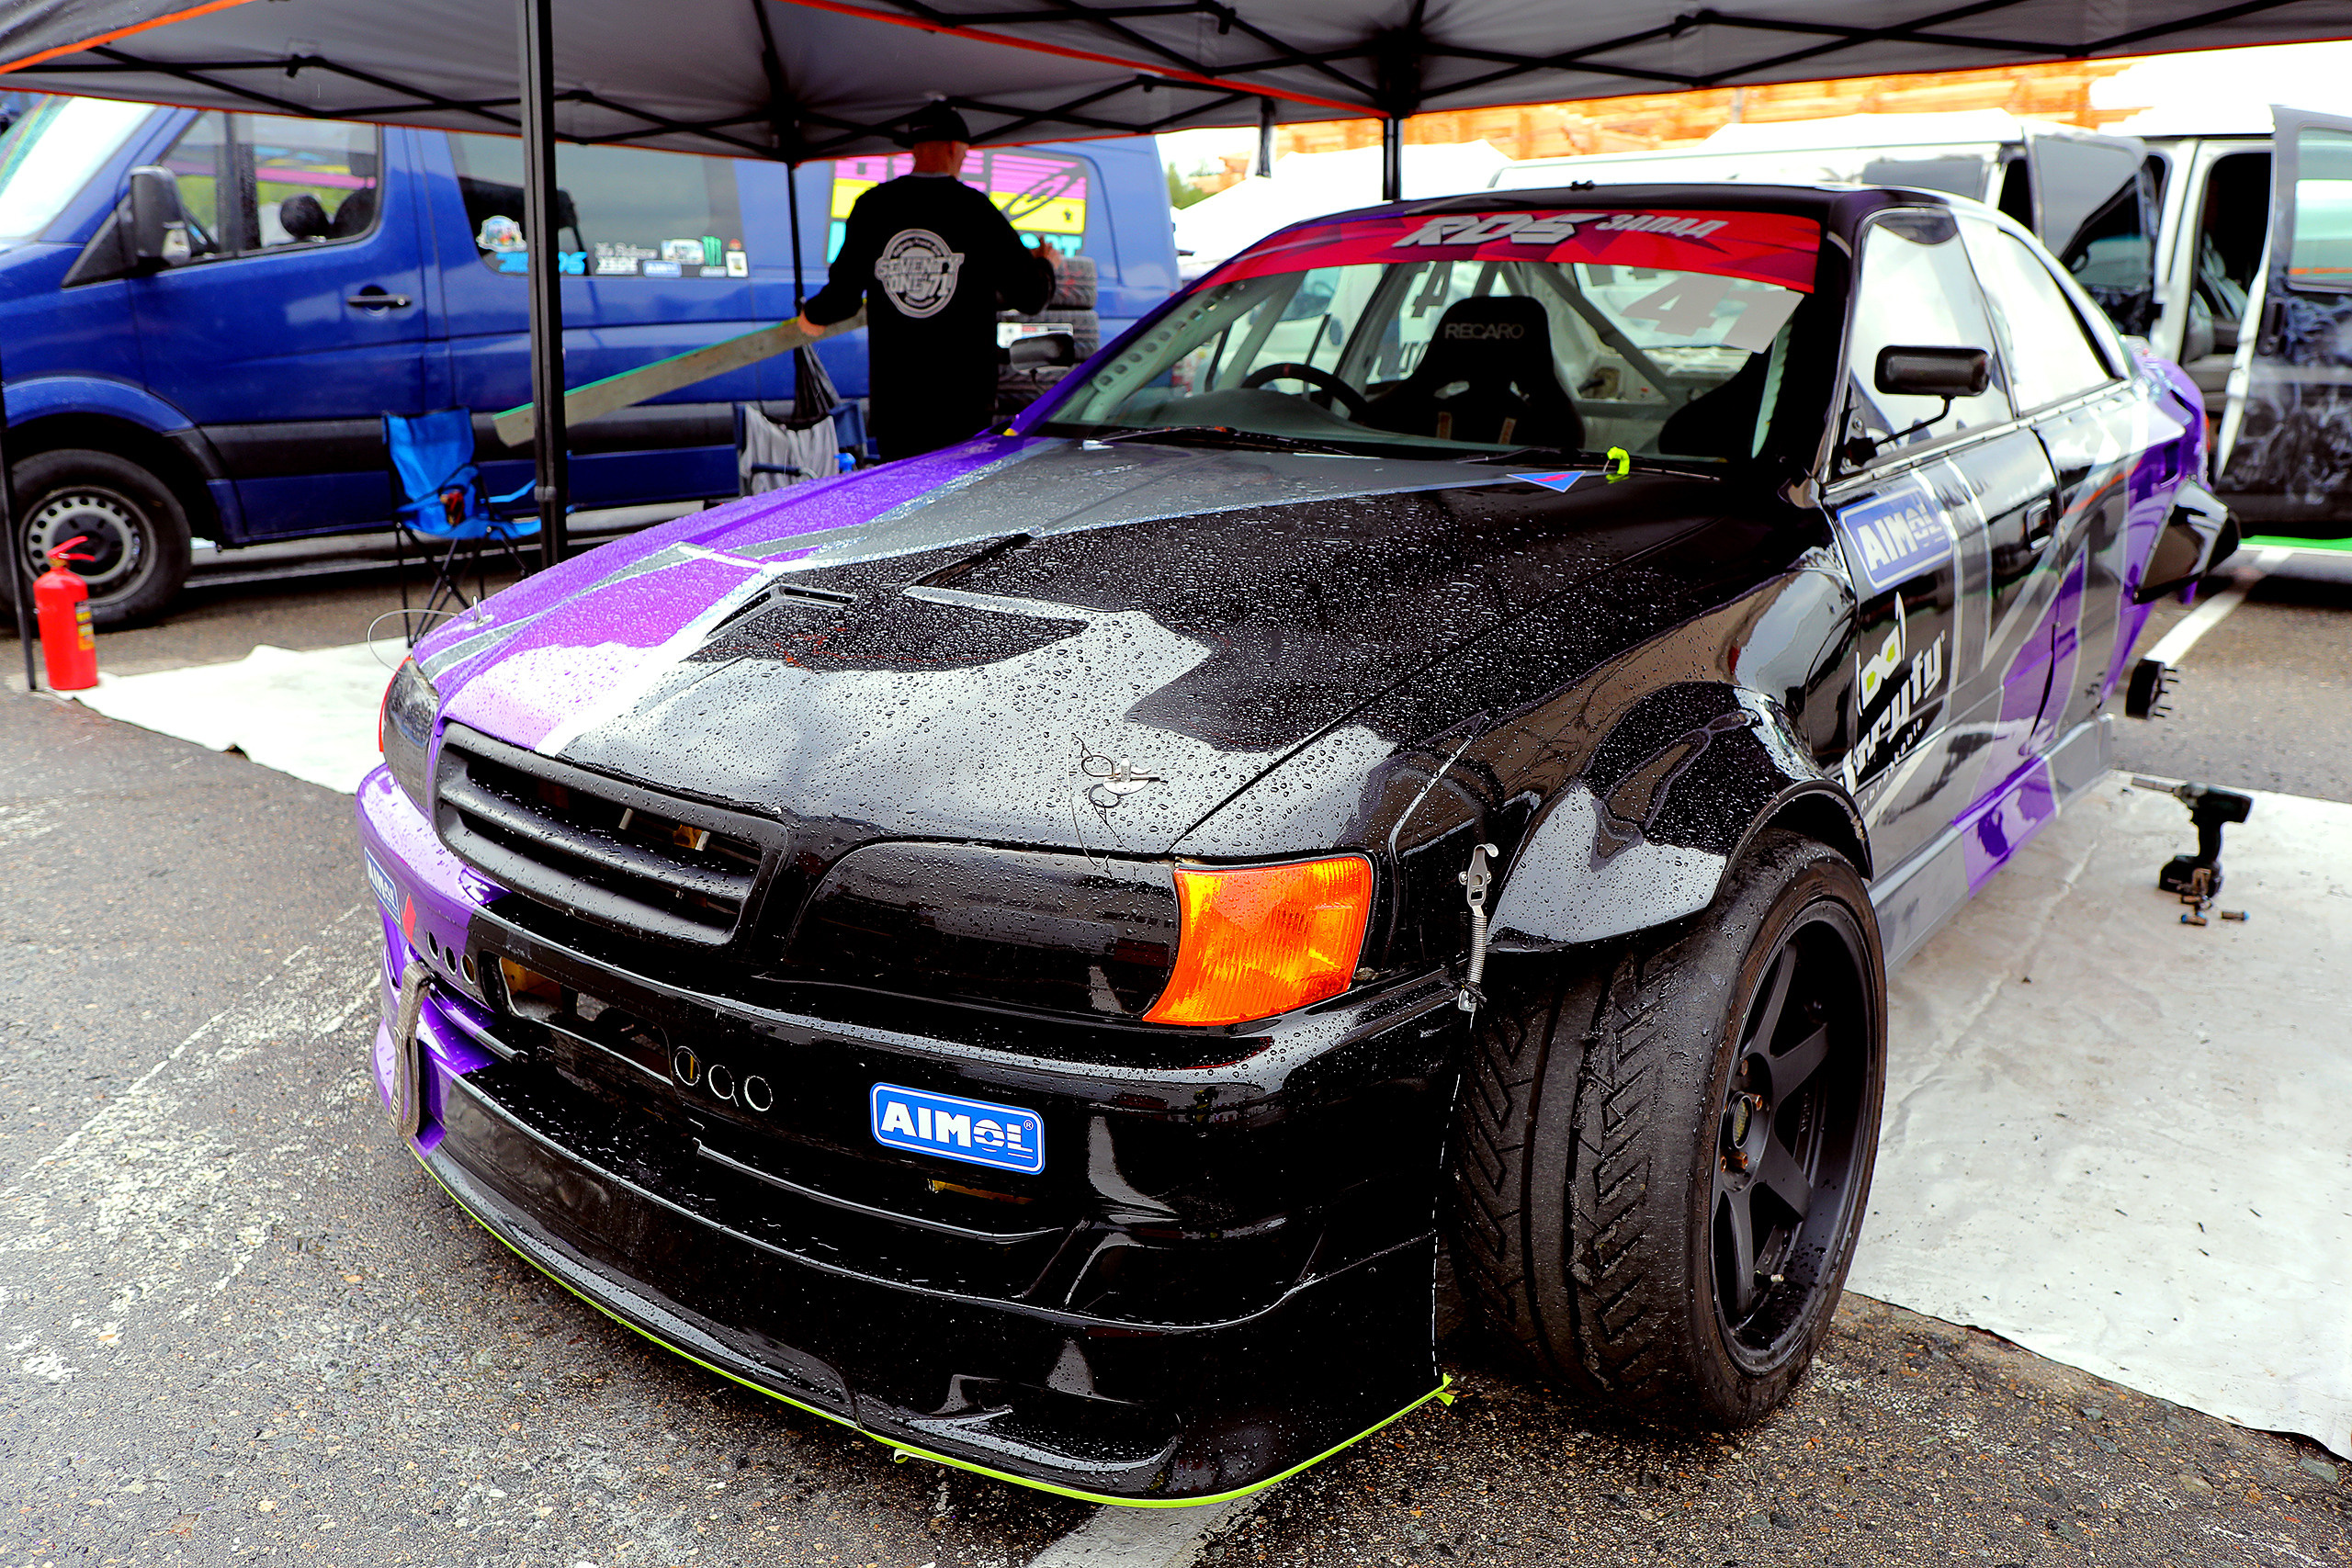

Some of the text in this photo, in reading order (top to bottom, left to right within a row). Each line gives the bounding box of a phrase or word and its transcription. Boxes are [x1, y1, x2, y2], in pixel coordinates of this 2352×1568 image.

[1392, 213, 1728, 248] RDS ЗАПАД
[876, 254, 964, 276] SEVENTY
[887, 274, 922, 292] ONE
[1445, 323, 1524, 340] RECARO
[1857, 502, 1943, 572] AIMOL
[1860, 718, 1923, 812] nbreakable
[880, 1100, 1034, 1158] AIMOL
